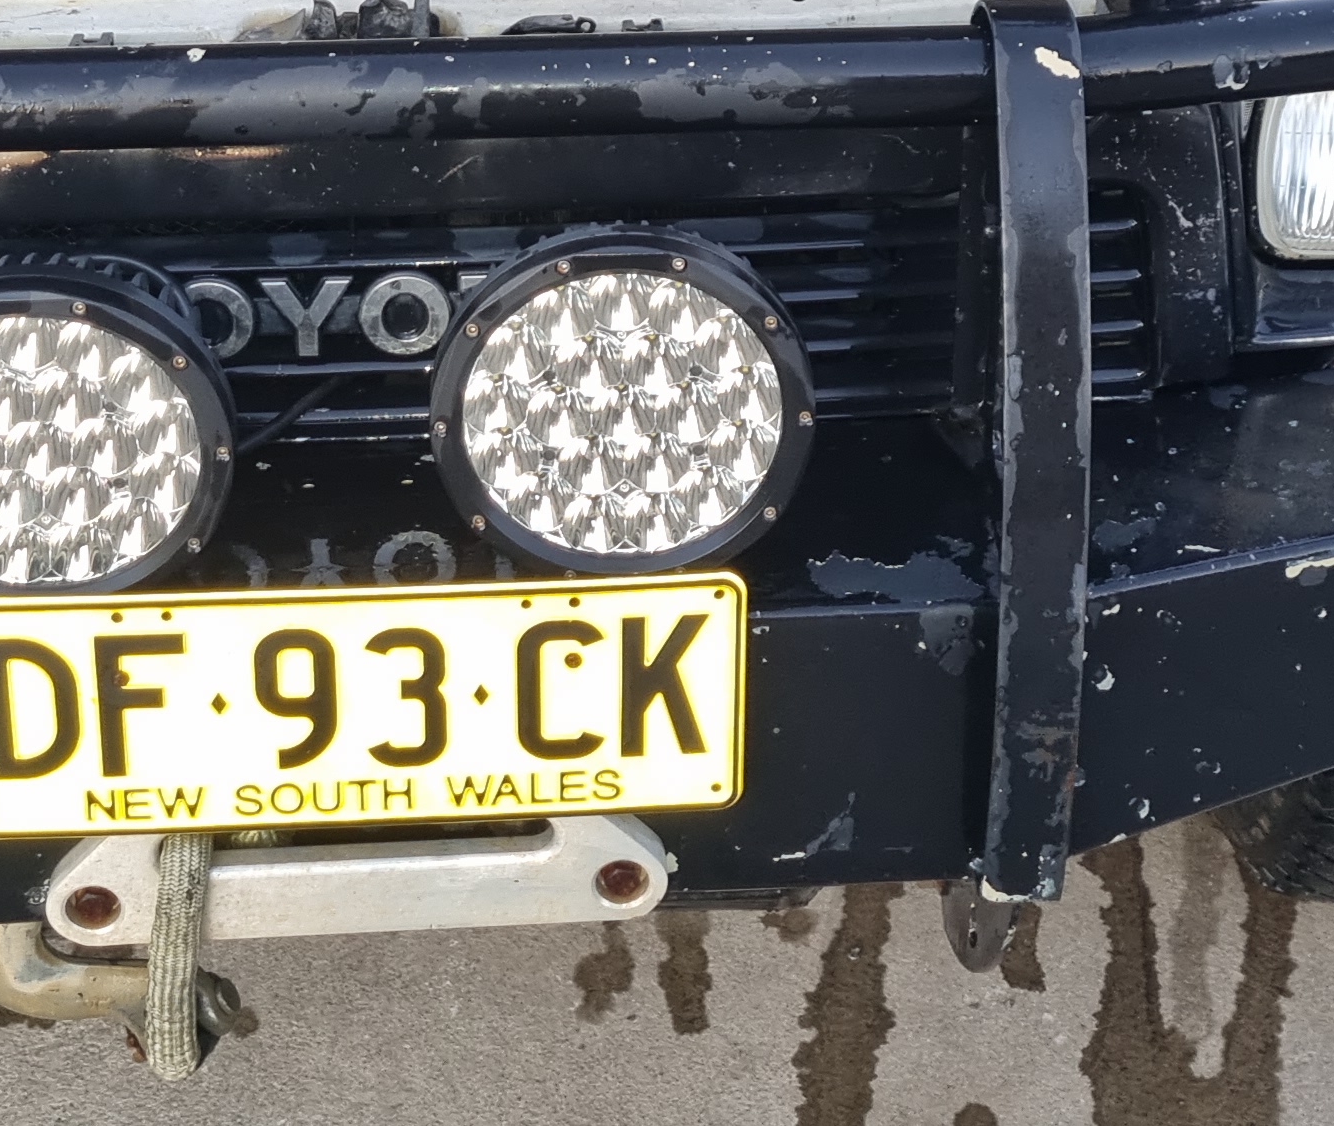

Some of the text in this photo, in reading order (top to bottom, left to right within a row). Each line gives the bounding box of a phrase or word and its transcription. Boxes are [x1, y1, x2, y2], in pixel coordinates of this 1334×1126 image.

[183, 271, 488, 360] OYO
[85, 769, 622, 821] NEW SOUTH WALES
